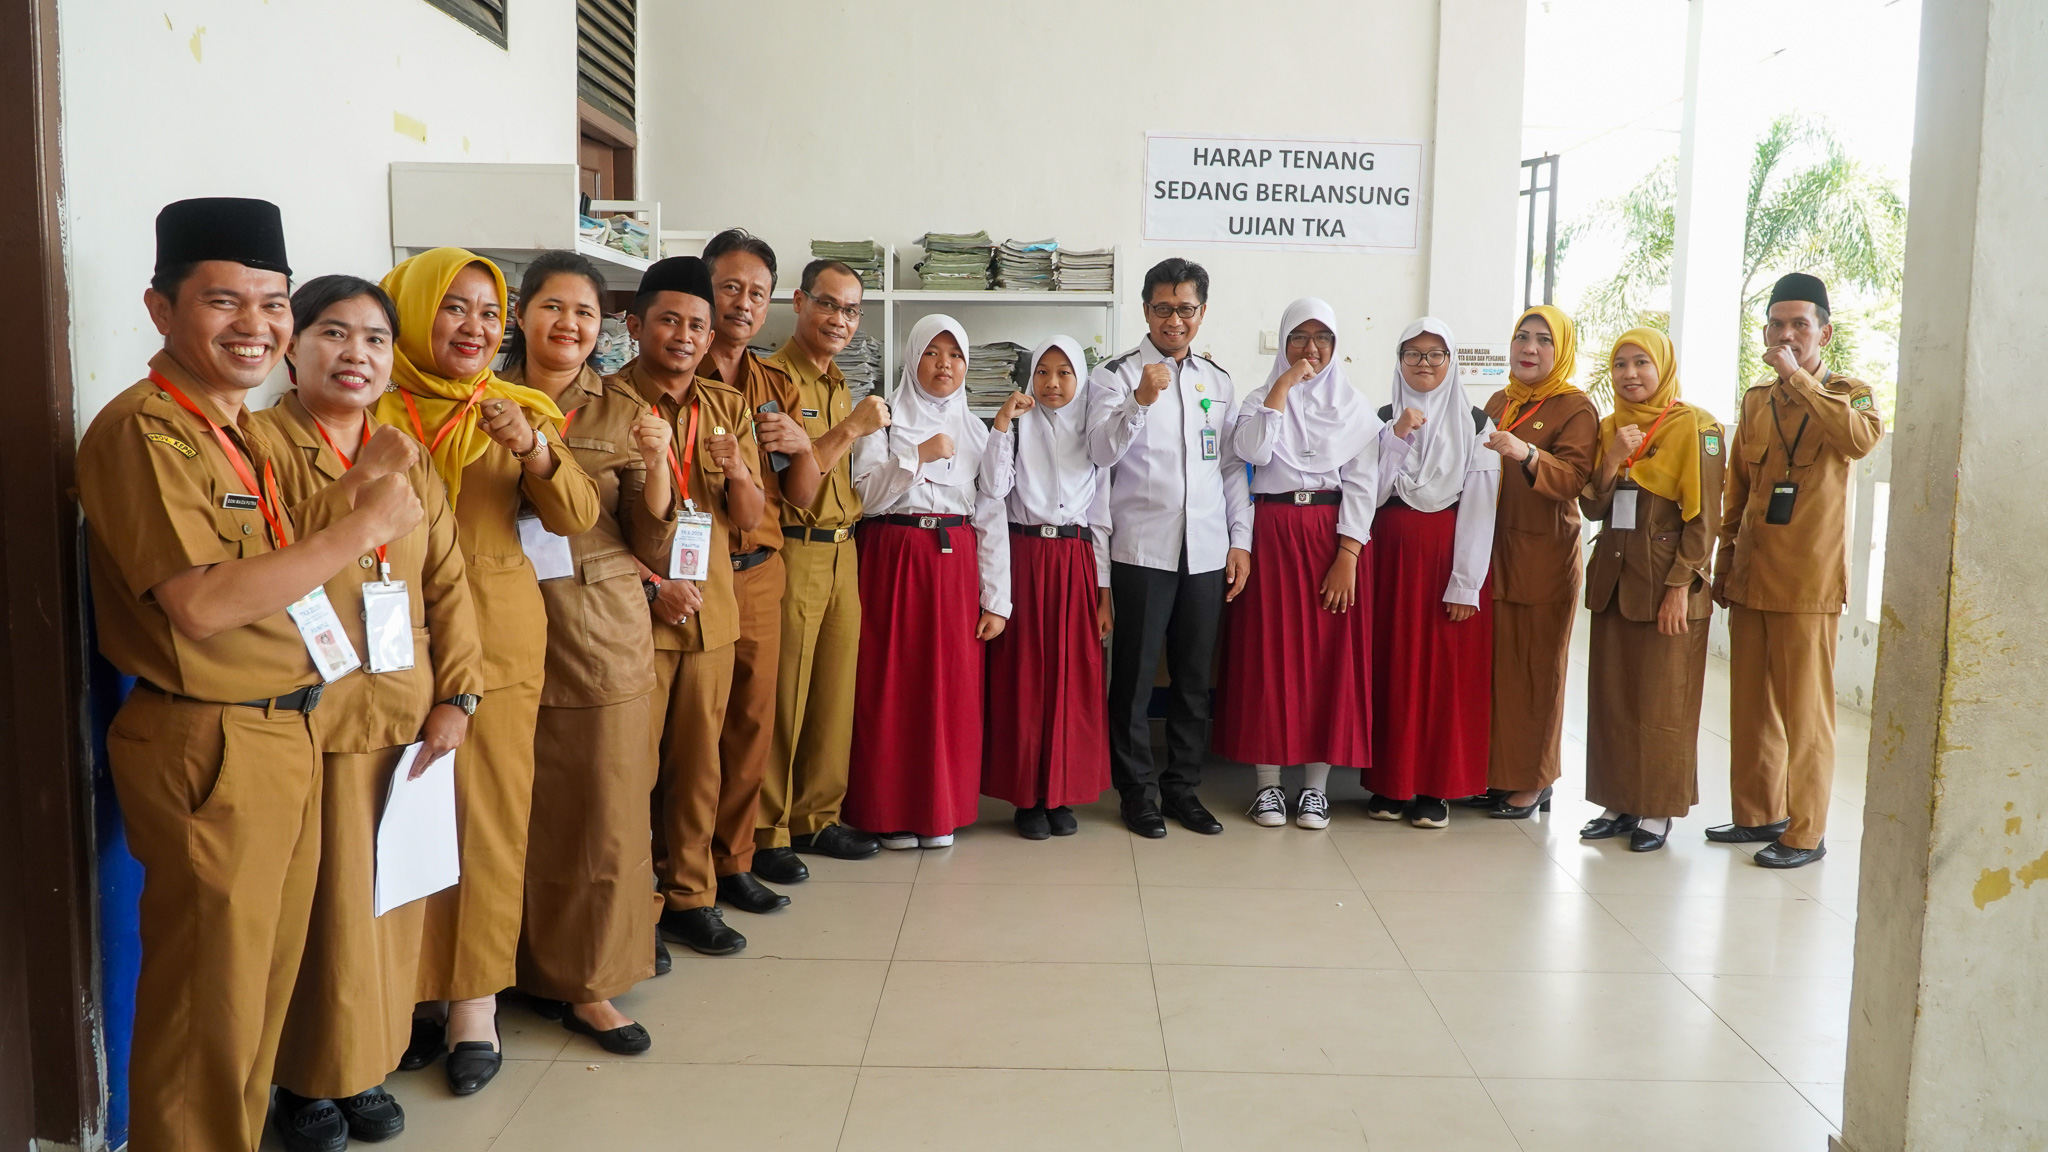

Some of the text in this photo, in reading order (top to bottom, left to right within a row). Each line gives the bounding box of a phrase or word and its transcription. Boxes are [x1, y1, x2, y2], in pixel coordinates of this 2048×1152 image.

[1193, 147, 1375, 171] HARAP TENANG
[1154, 180, 1410, 206] SEDANG BERLANSUNG
[1228, 216, 1346, 238] UJIAN TKA
[173, 440, 195, 457] KEPRI
